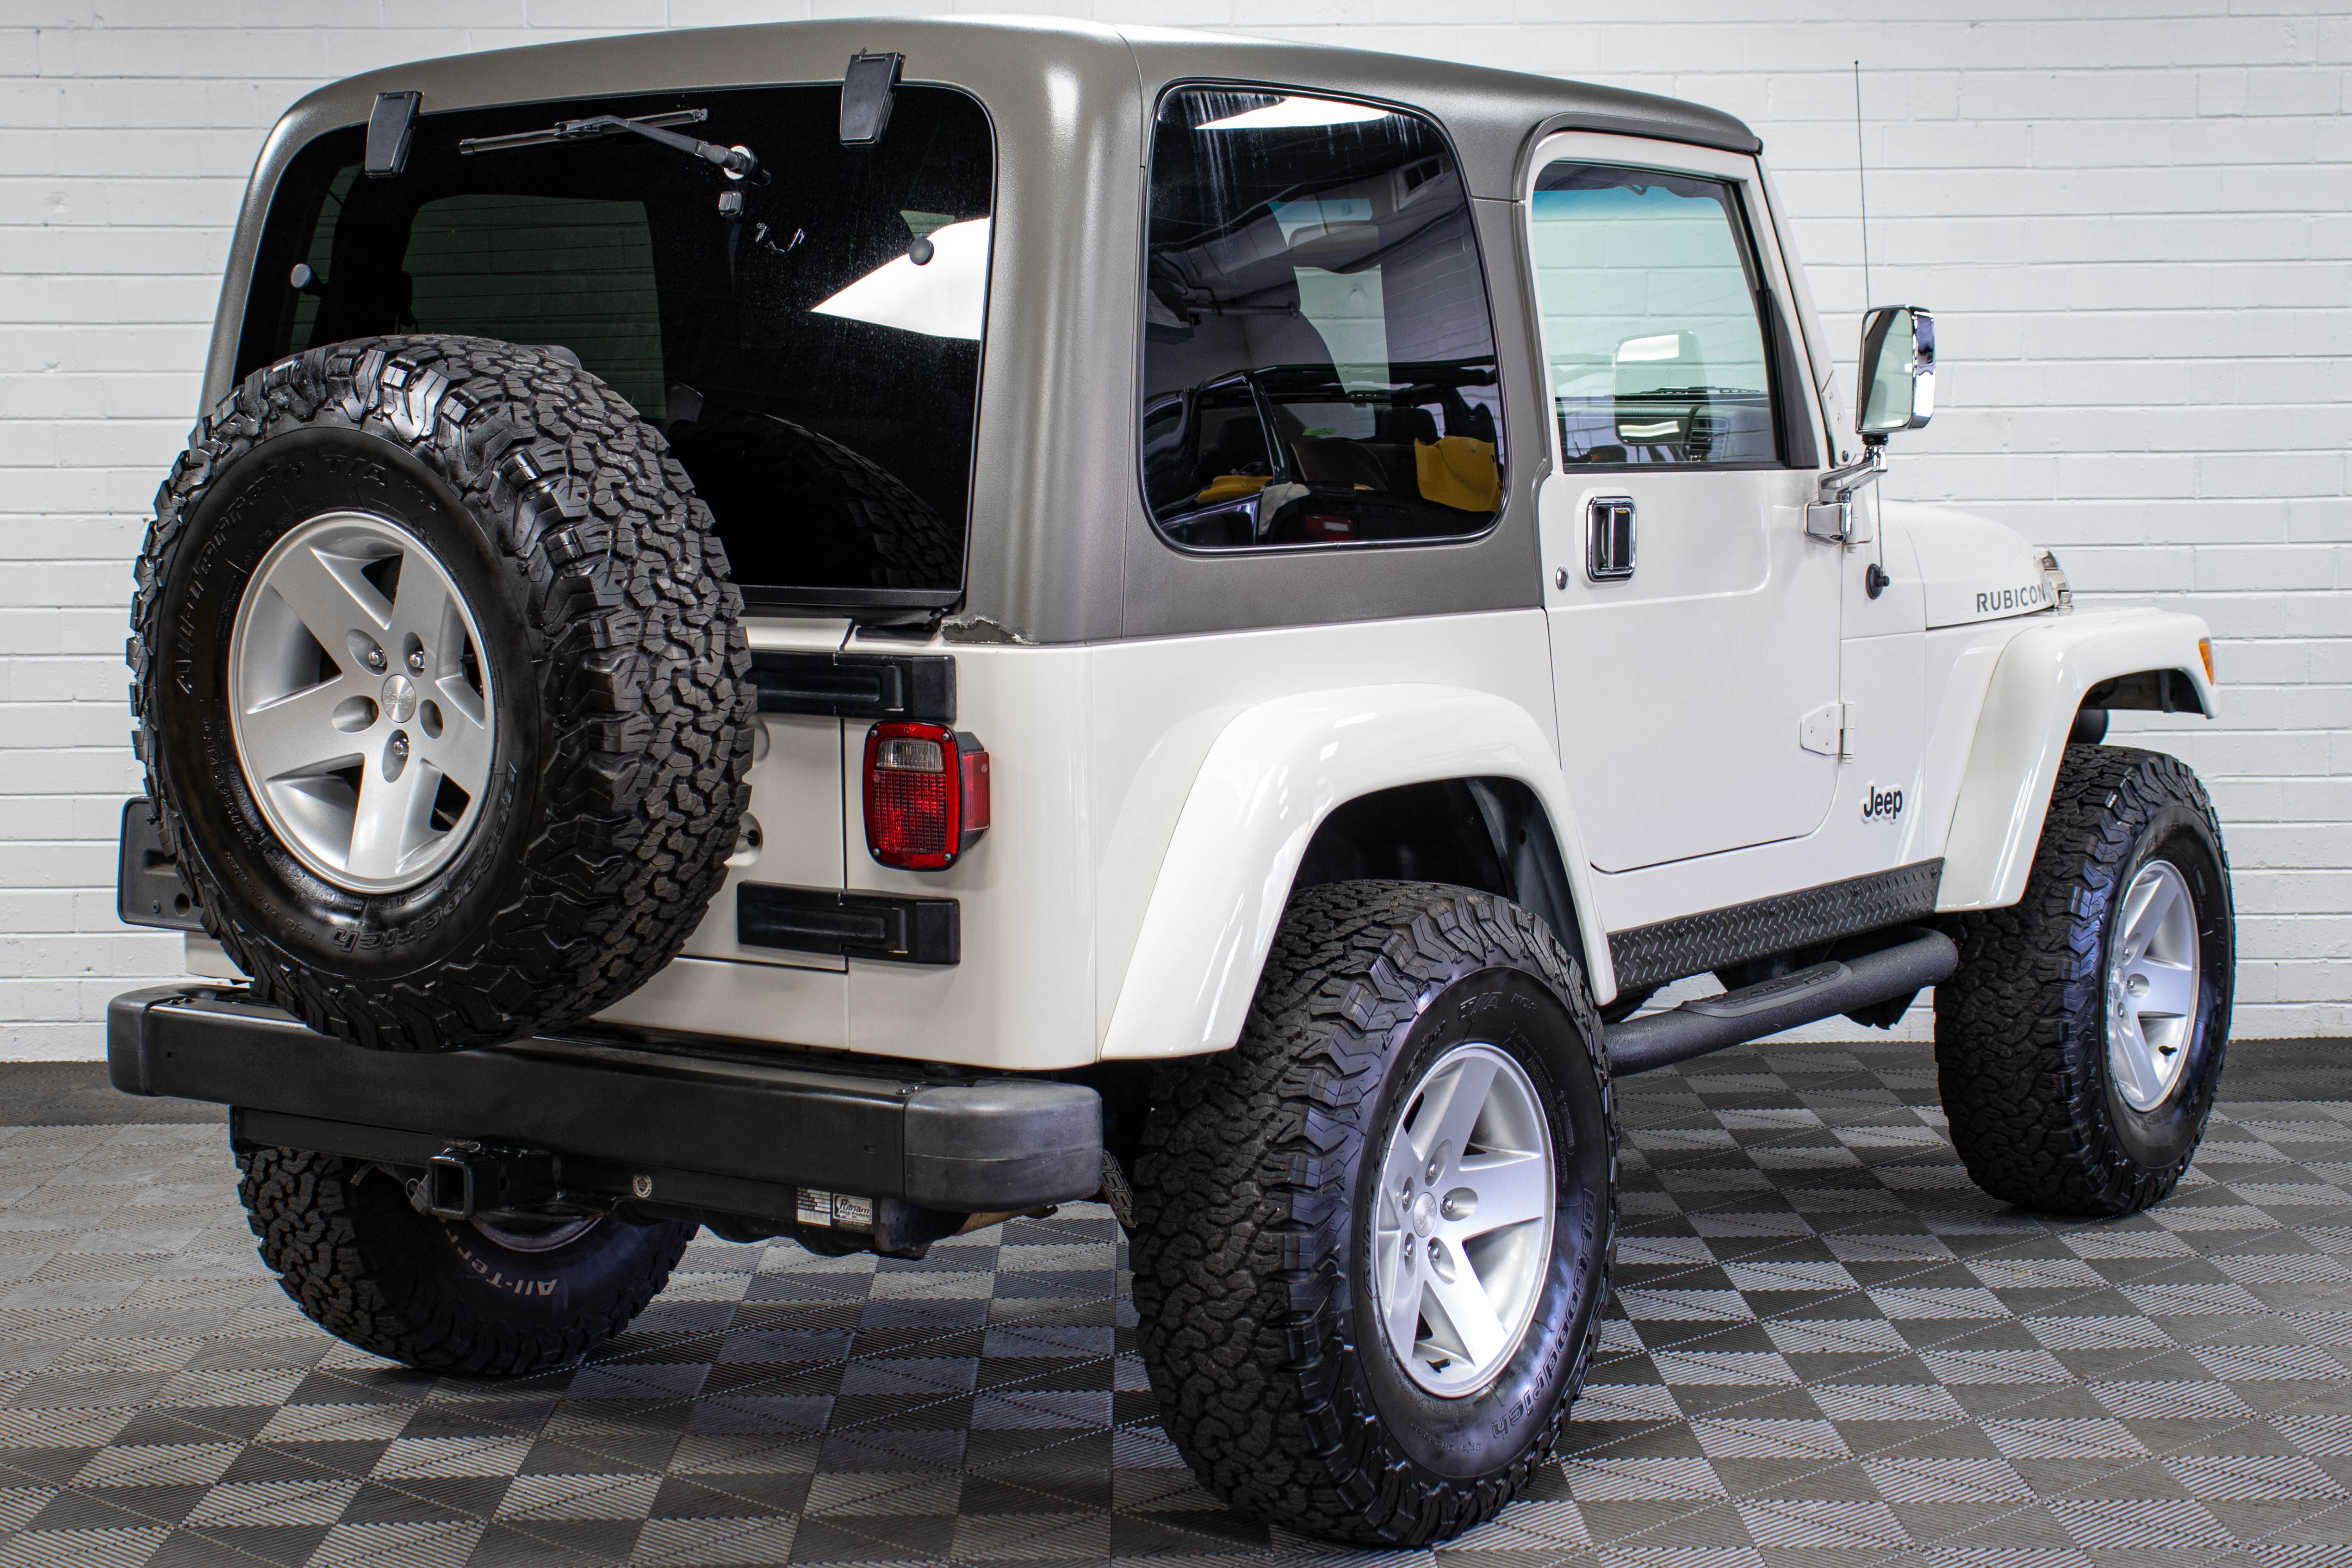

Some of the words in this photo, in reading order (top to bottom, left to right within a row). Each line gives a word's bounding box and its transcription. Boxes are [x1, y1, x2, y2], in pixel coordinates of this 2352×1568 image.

[1976, 583, 2046, 613] RUBICON
[1863, 786, 1903, 819] Jeep
[331, 760, 518, 952] BFGoodrich
[840, 1199, 869, 1214] Putnam
[1491, 1188, 1595, 1439] BFGoodrich
